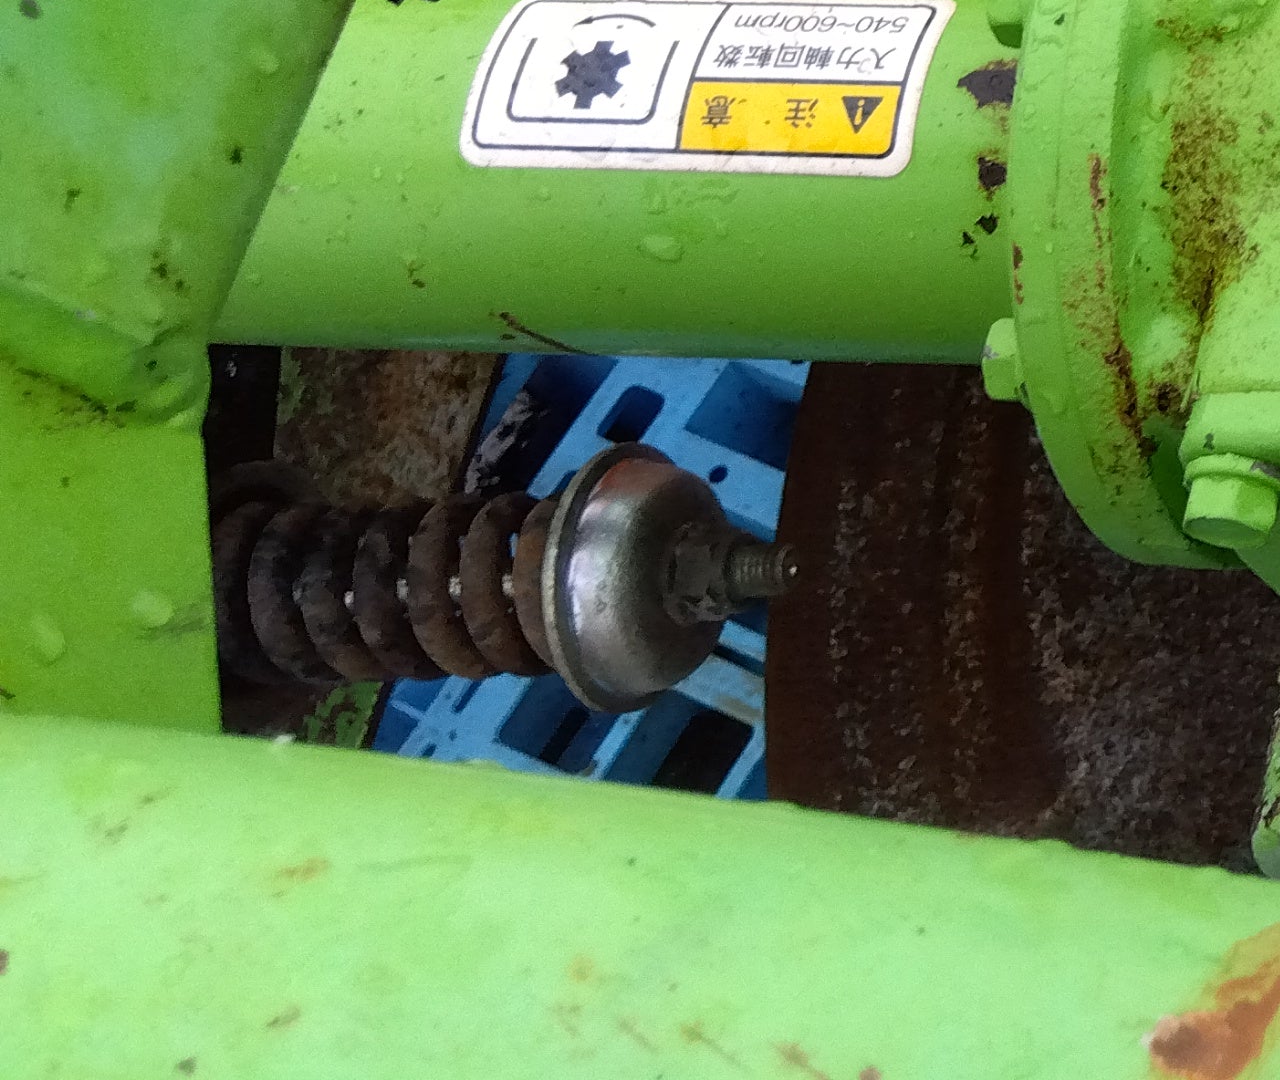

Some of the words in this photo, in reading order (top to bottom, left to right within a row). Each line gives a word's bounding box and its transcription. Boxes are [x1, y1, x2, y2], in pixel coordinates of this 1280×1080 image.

[714, 43, 897, 70] 入力軸回転数
